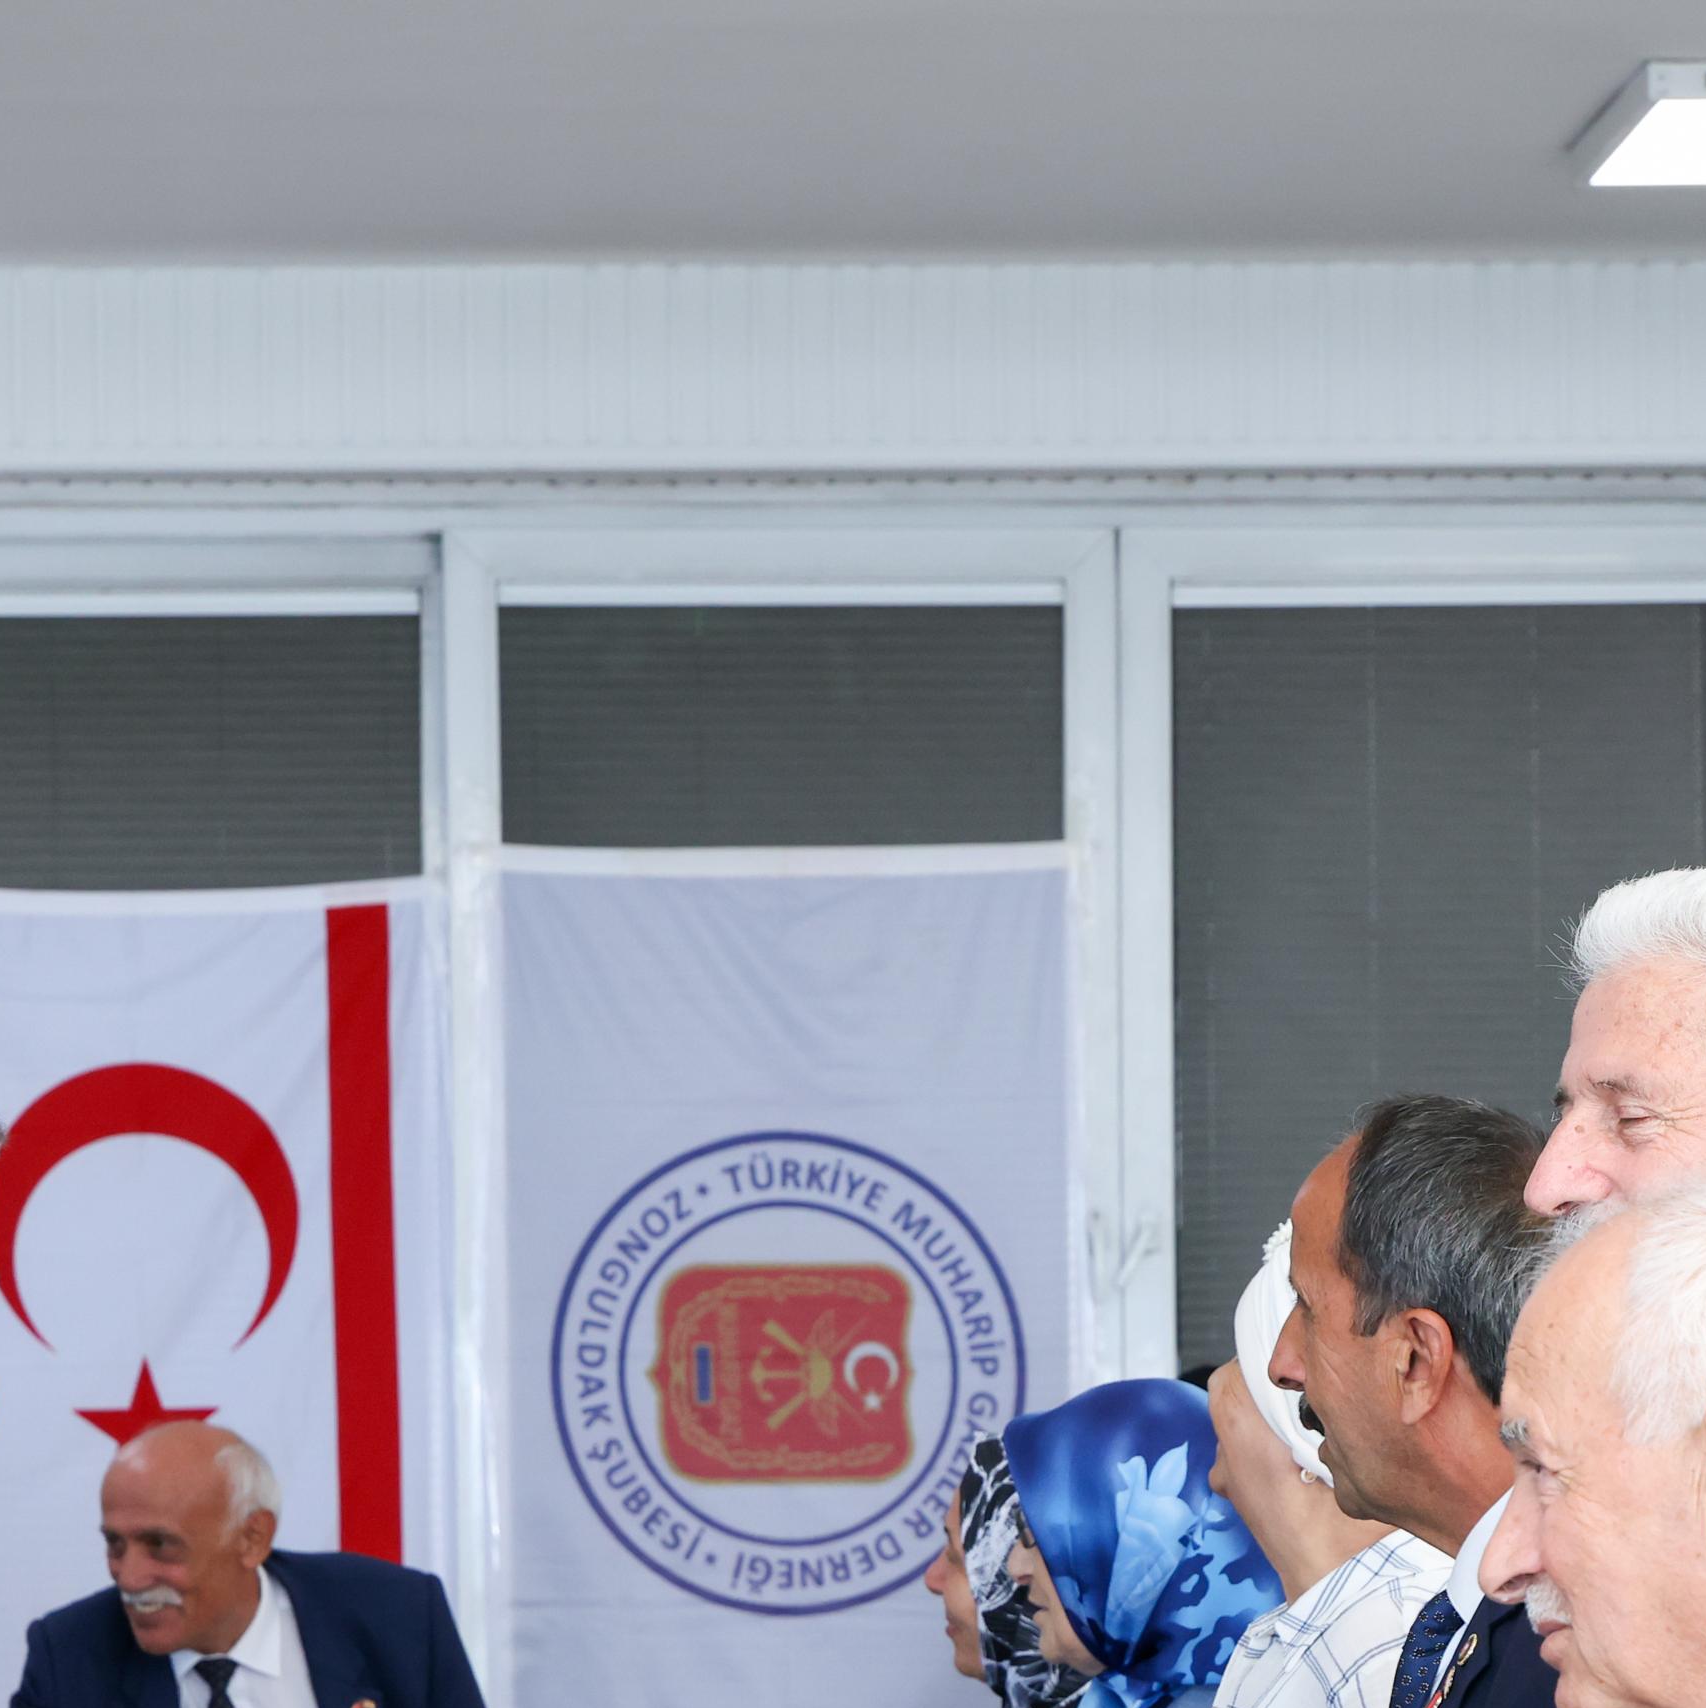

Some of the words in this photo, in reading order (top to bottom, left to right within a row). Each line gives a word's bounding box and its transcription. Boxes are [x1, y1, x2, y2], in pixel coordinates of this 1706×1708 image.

[722, 1152, 888, 1212] TÜRKİYE
[577, 1189, 693, 1429] ZONGULDAK
[891, 1200, 1005, 1377] MUHARİP
[587, 1437, 705, 1561] ŞUBESİ
[730, 1532, 904, 1594] DERNEĞİ
